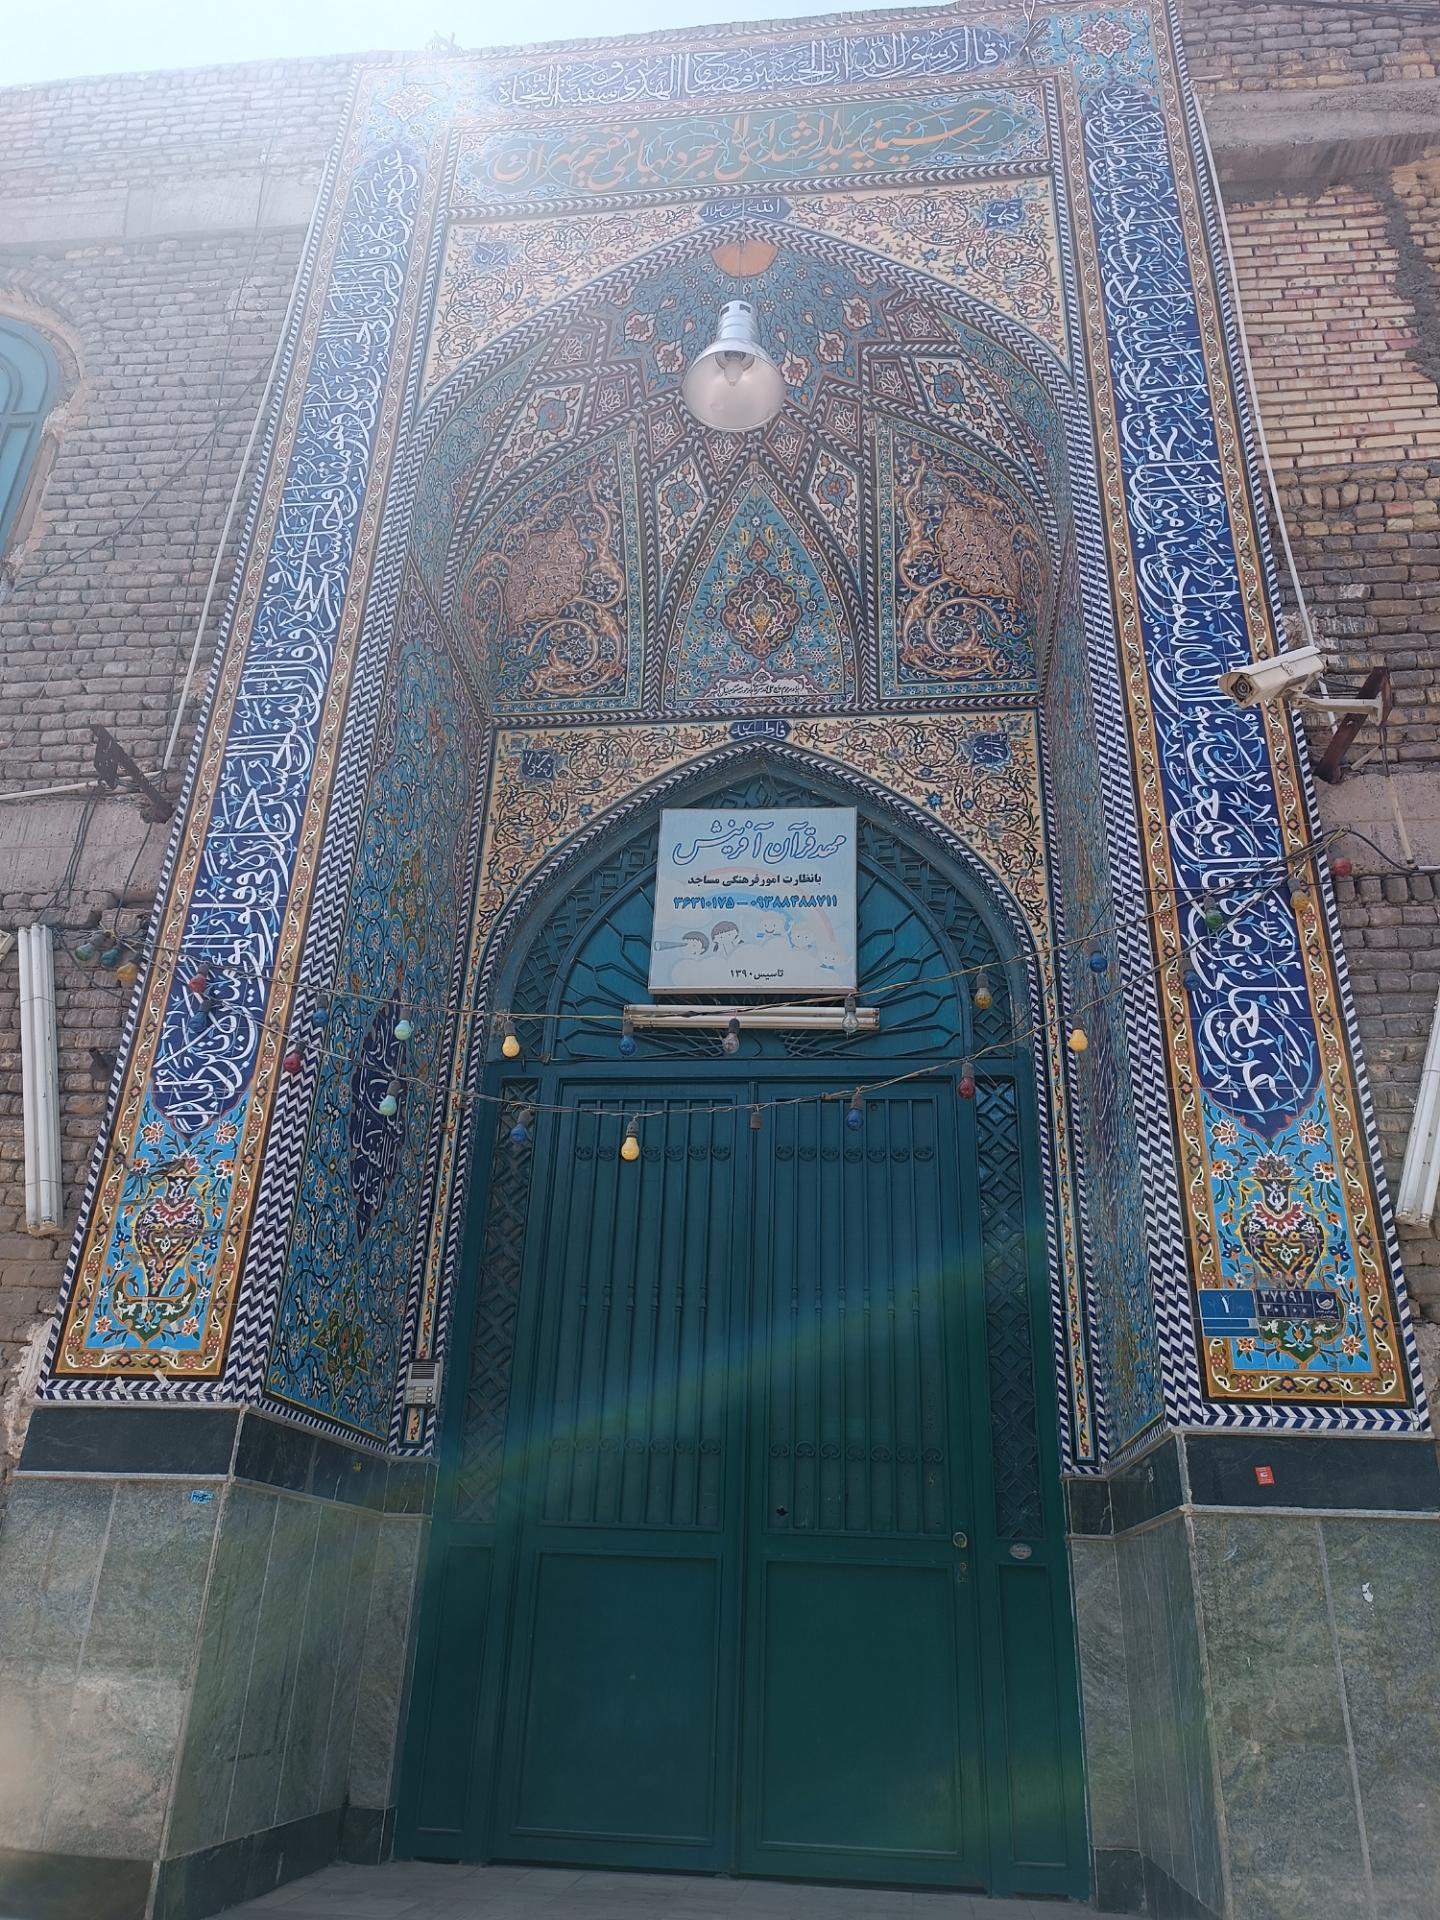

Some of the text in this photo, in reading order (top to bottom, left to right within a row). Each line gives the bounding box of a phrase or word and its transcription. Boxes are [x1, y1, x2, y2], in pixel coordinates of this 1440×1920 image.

[672, 819, 847, 866] مهد قرآن آفرینش
[687, 875, 720, 887] مساجد
